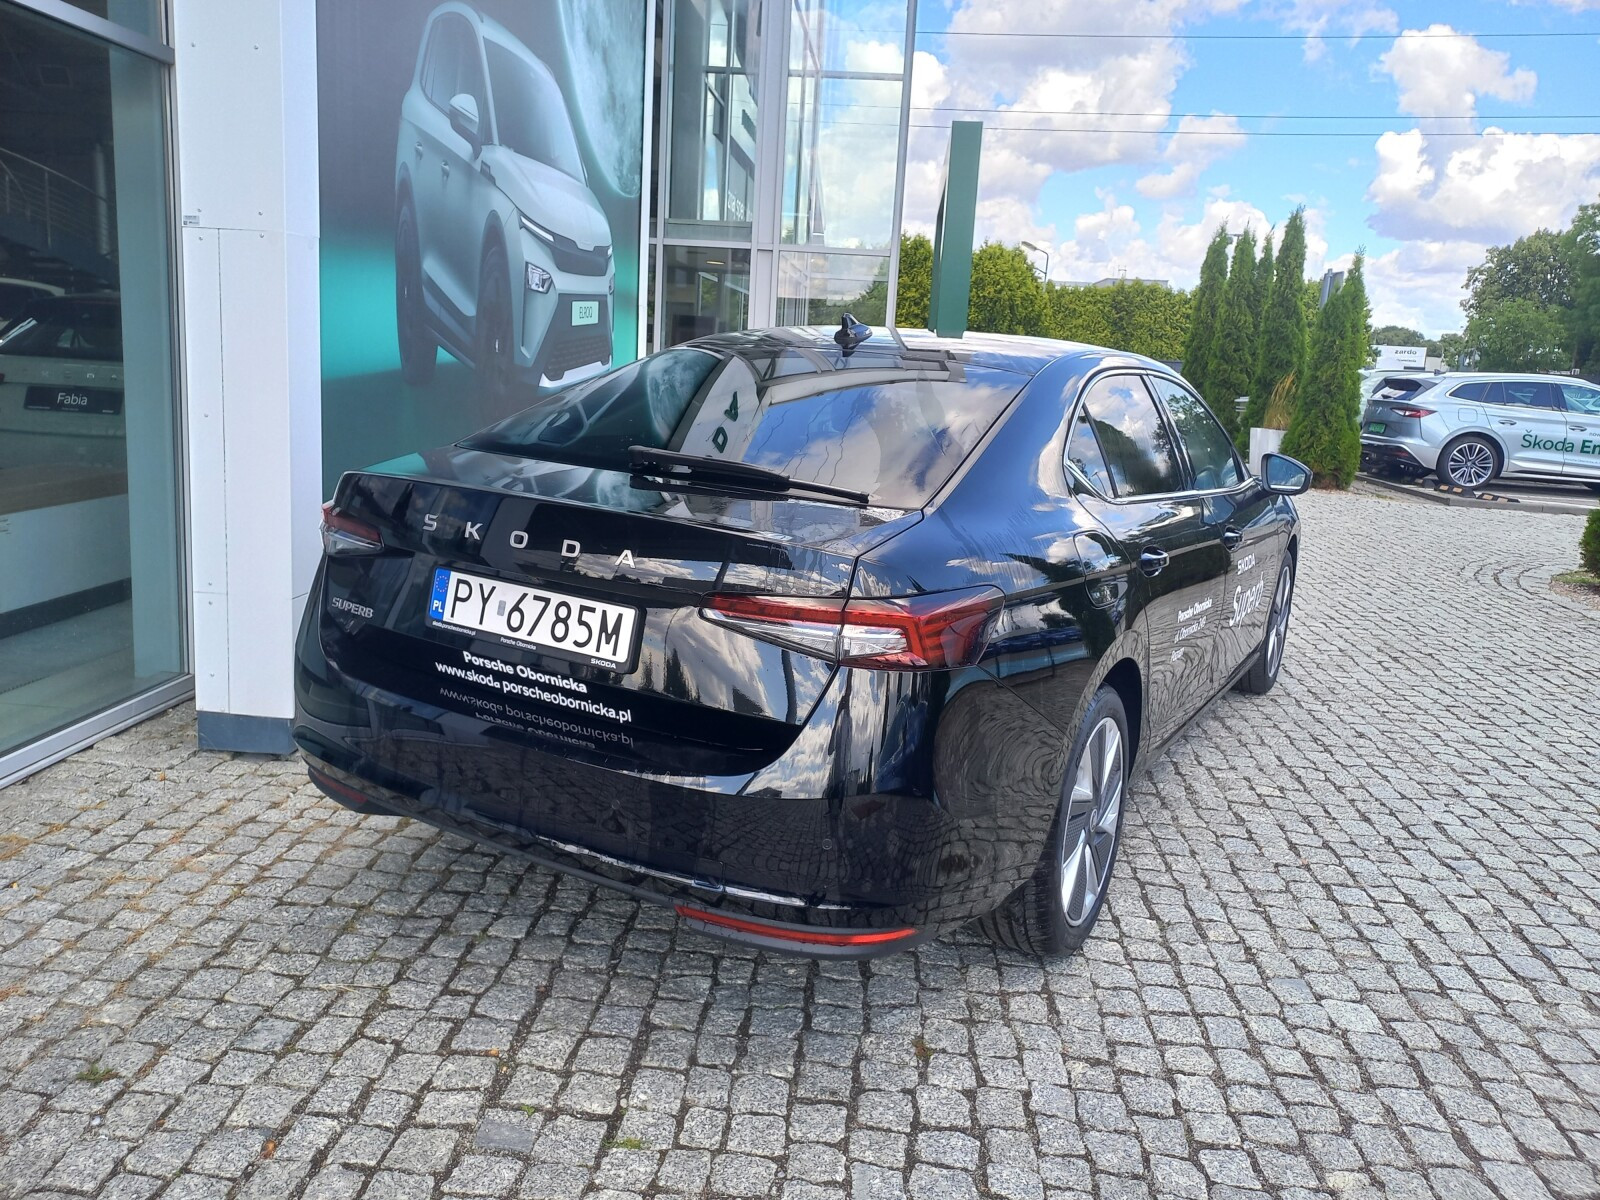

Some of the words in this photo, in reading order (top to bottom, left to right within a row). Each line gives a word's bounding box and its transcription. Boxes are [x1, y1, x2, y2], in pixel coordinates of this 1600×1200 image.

[57, 392, 88, 406] Fabia
[1520, 429, 1575, 453] Škoda
[331, 596, 375, 619] SUPERB
[432, 599, 443, 613] PL
[450, 578, 496, 625] PY
[506, 592, 624, 657] 6785M
[500, 636, 516, 646] Porsche
[463, 650, 515, 675] Porsche
[516, 665, 588, 694] Obornicka
